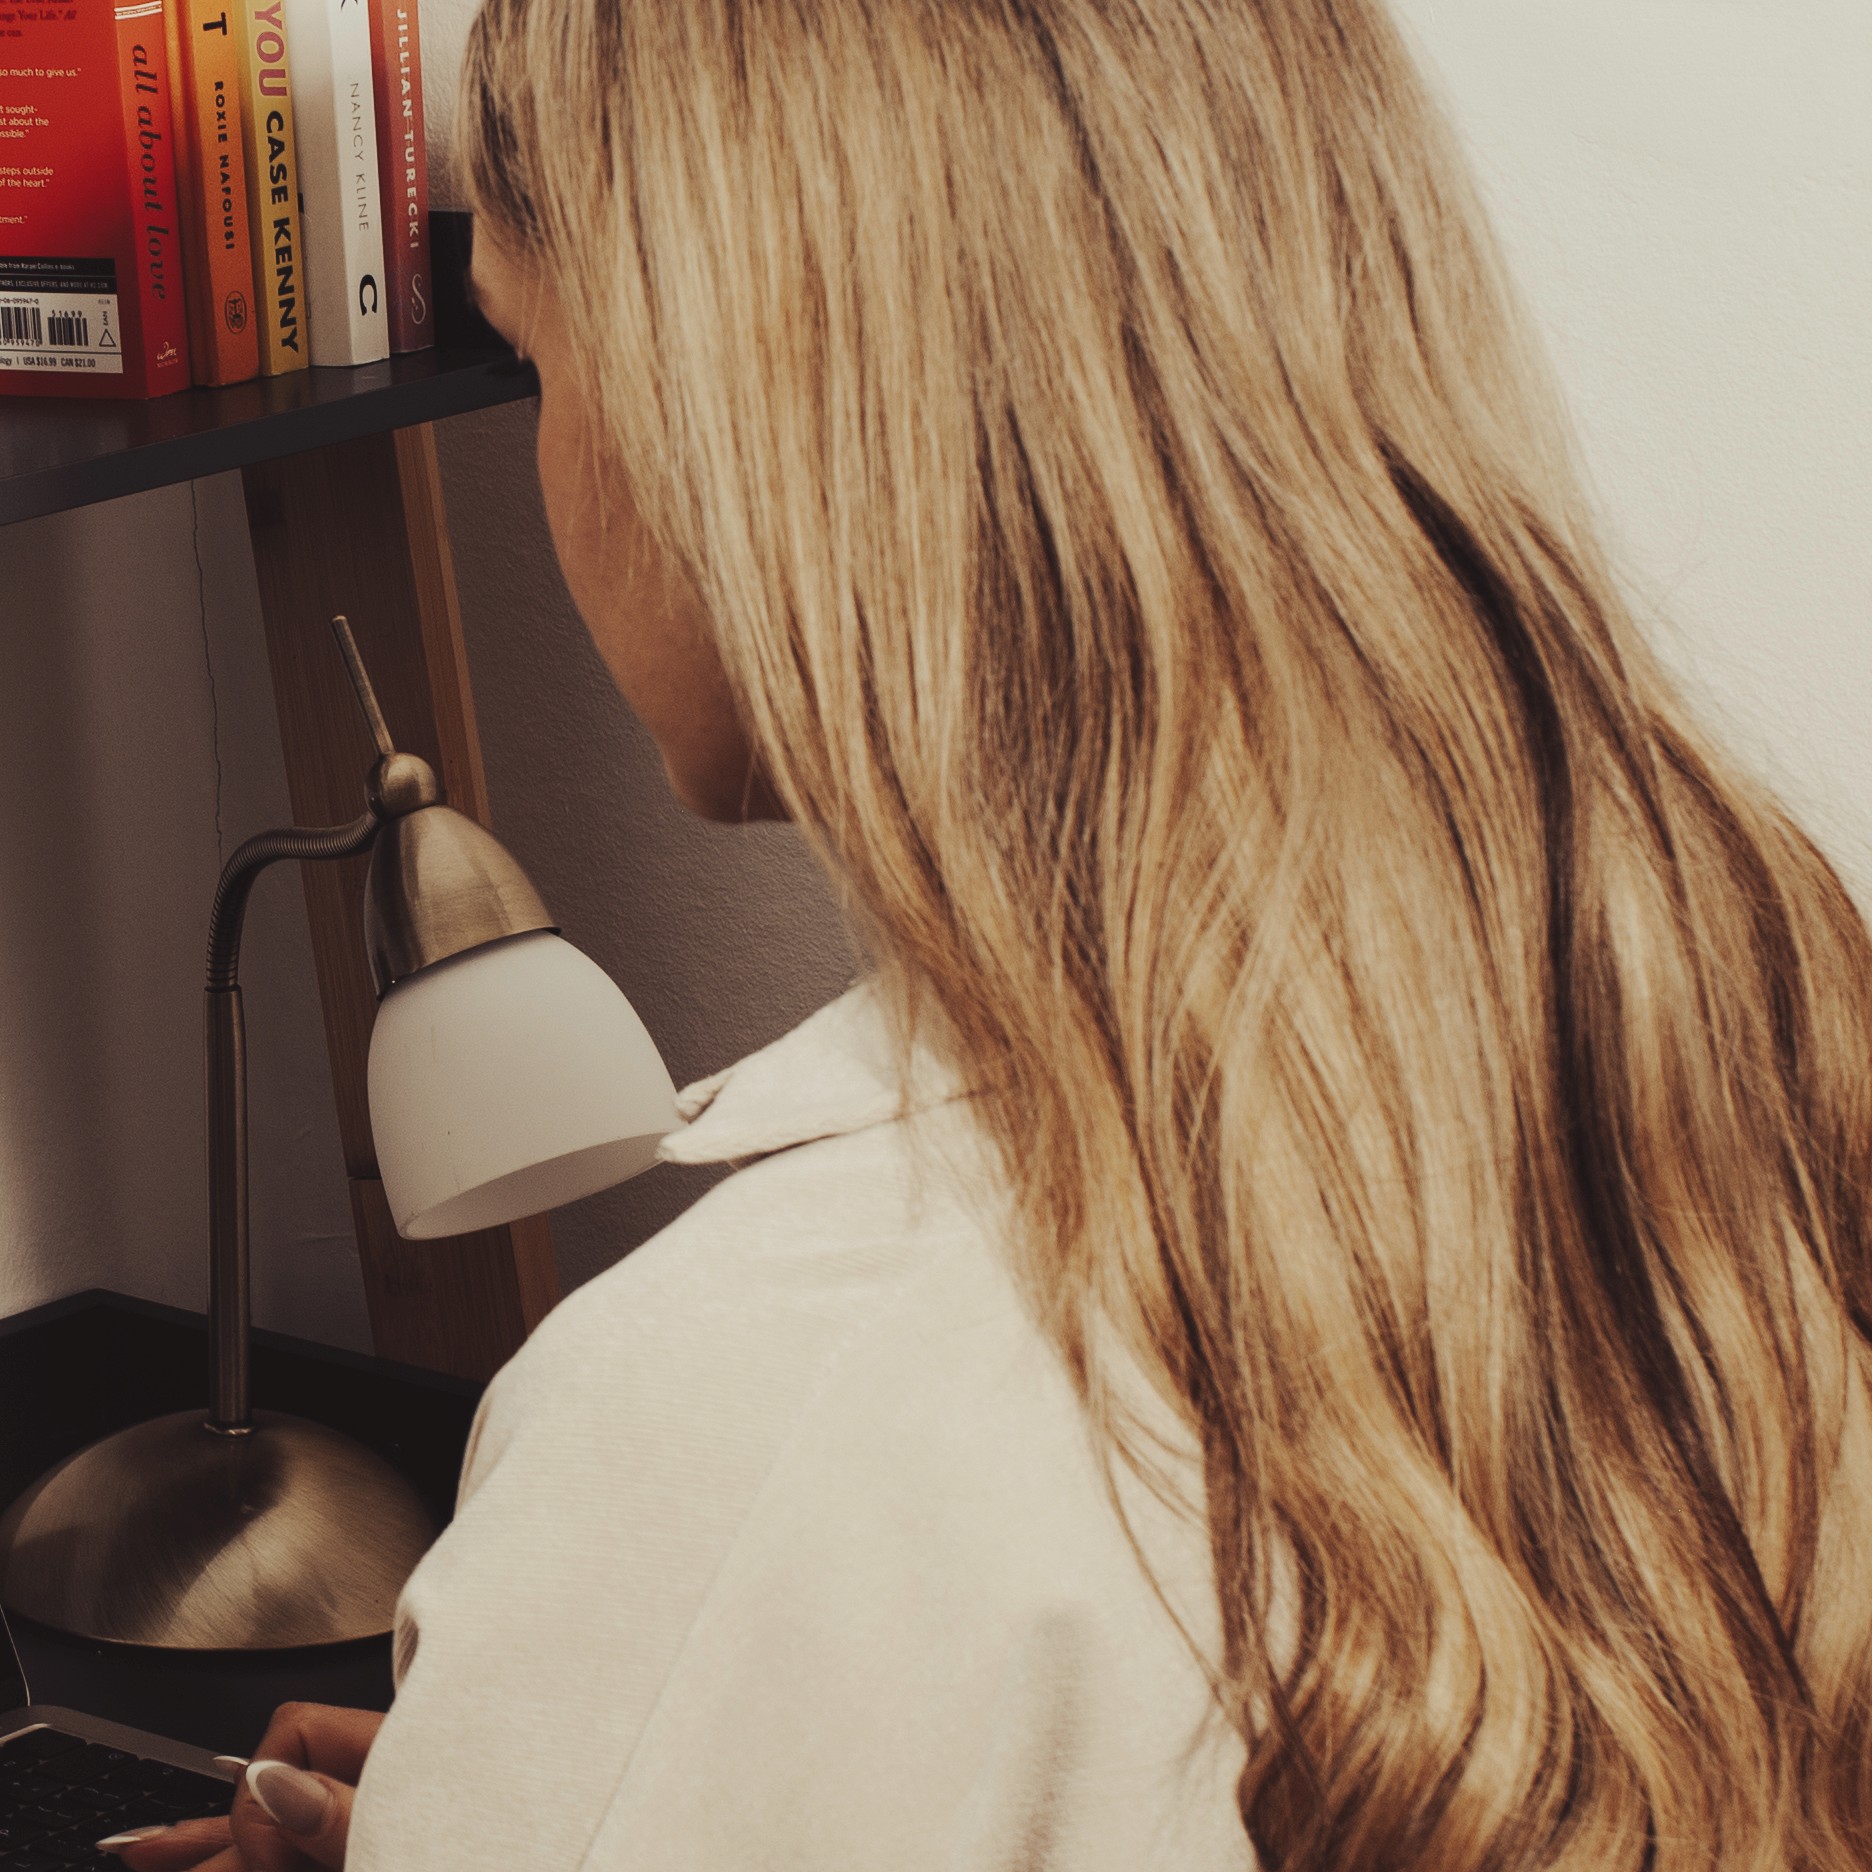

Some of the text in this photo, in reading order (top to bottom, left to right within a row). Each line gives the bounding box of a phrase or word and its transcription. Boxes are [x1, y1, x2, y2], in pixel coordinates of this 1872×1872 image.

[132, 43, 158, 94] all
[252, 0, 288, 97] YOU
[136, 107, 163, 212] about
[214, 80, 235, 251] ROXIE NAFOUSI
[350, 82, 370, 232] NANCY KLINE
[396, 9, 420, 249] JILLIAN TURECKI
[147, 224, 170, 301] love
[266, 110, 300, 353] CASE KENNY
[23, 356, 35, 366] USA
[37, 356, 57, 367] $16.99
[60, 356, 73, 367] CAN
[75, 357, 96, 368] $21.00
